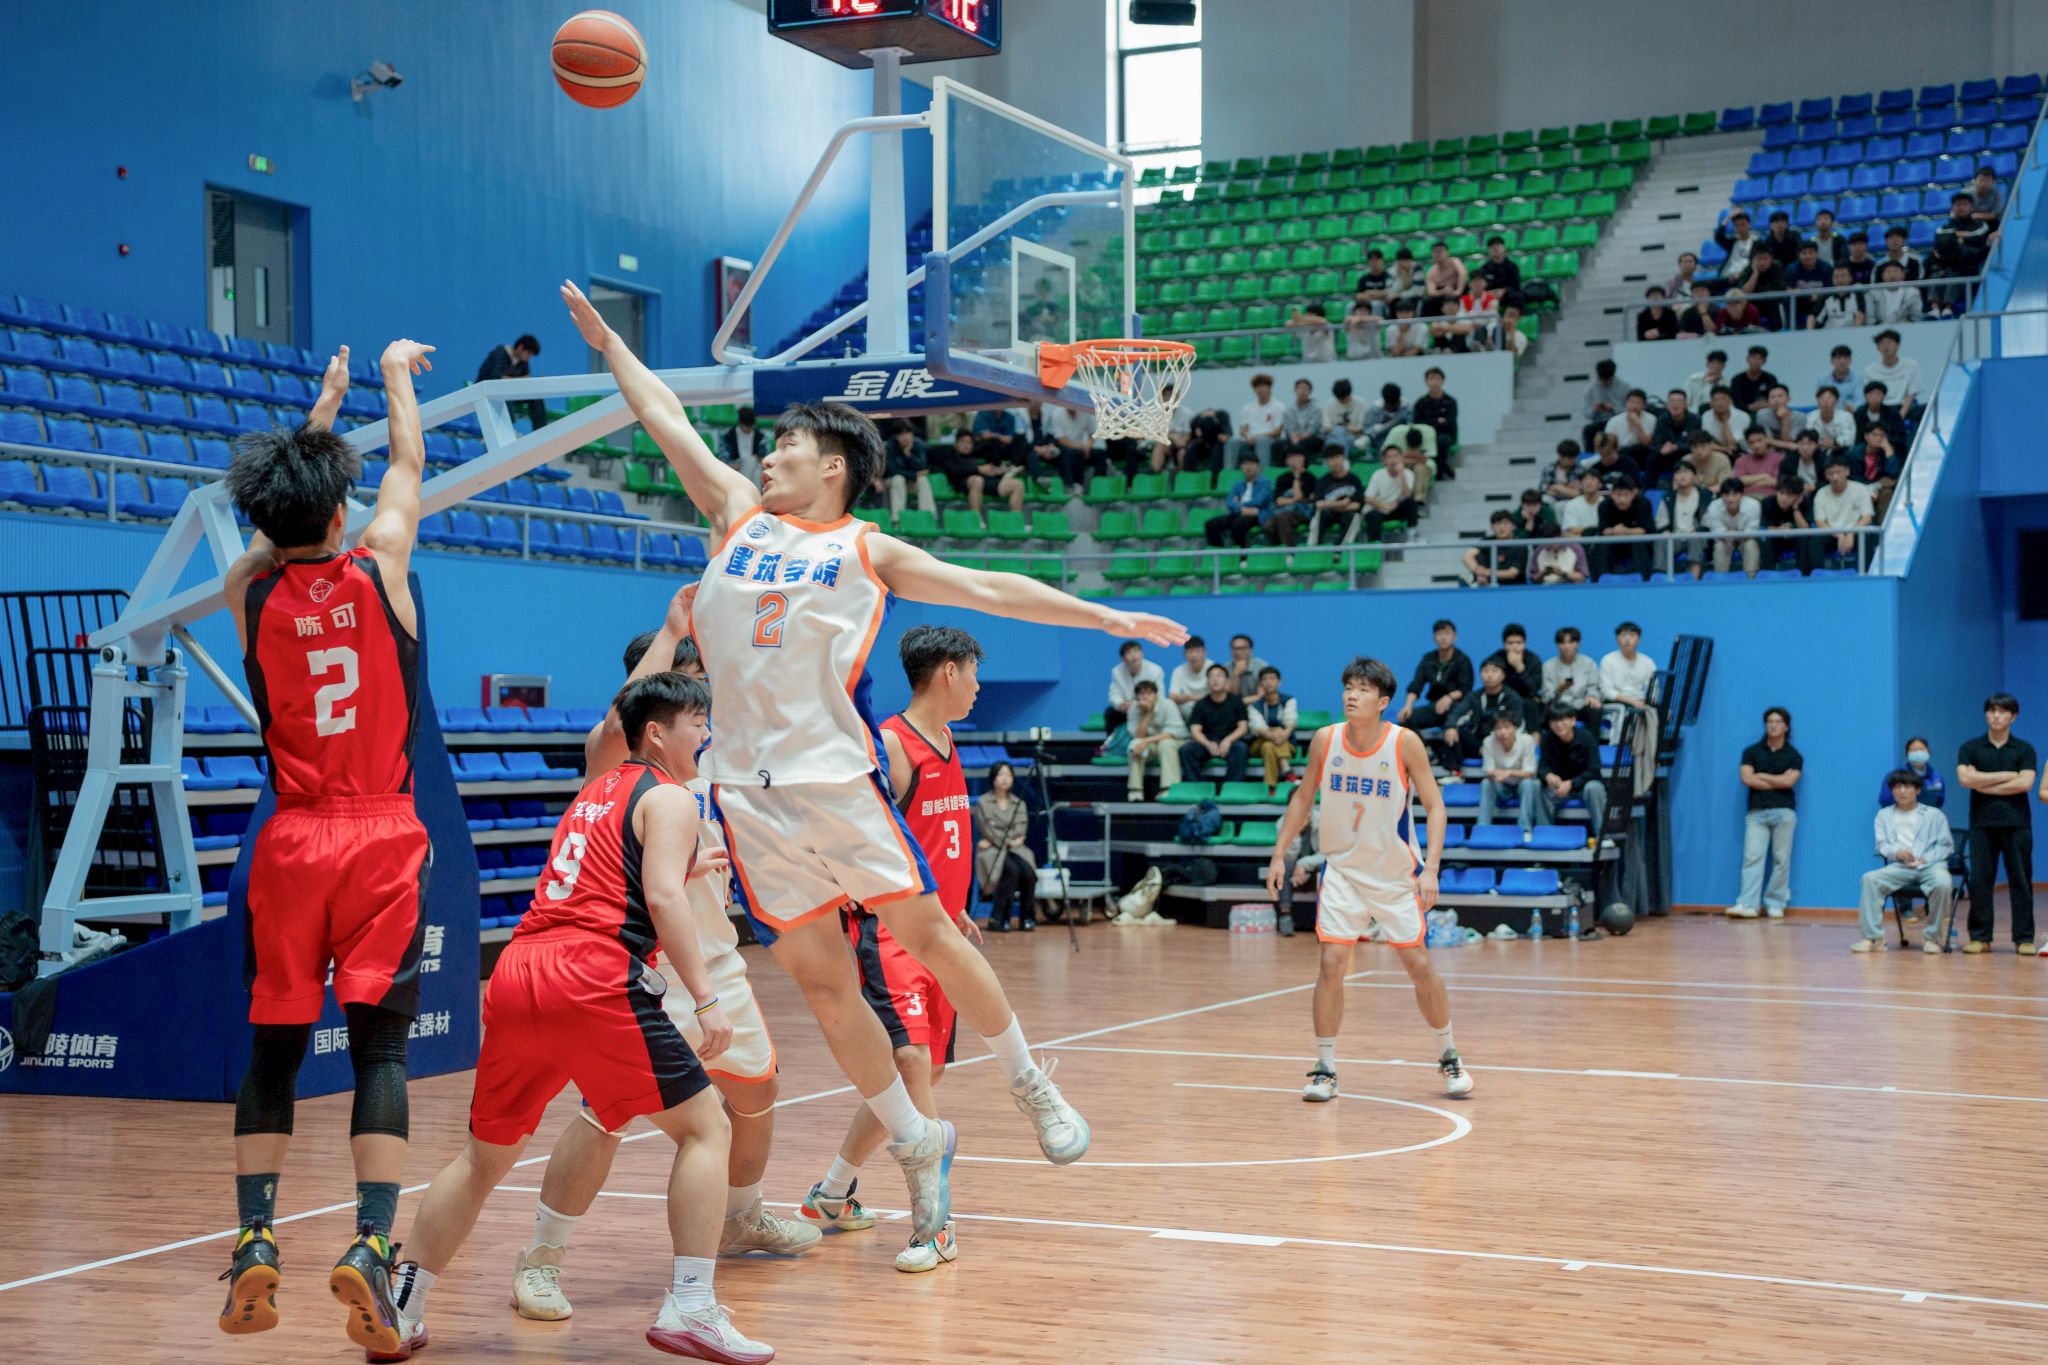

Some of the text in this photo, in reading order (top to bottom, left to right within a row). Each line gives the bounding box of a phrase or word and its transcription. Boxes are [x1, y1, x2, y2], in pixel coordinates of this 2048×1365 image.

[822, 367, 959, 401] 金陵
[723, 544, 844, 590] 建筑学院
[752, 591, 788, 648] 2
[306, 646, 360, 737] 2
[1329, 773, 1391, 799] 建筑学院
[1351, 801, 1365, 833] 7
[943, 820, 960, 859] 3
[545, 831, 588, 900] 9
[905, 992, 923, 1016] 3
[20, 1056, 114, 1069] JINLING SPORTS
[43, 1033, 118, 1058] 陵体育
